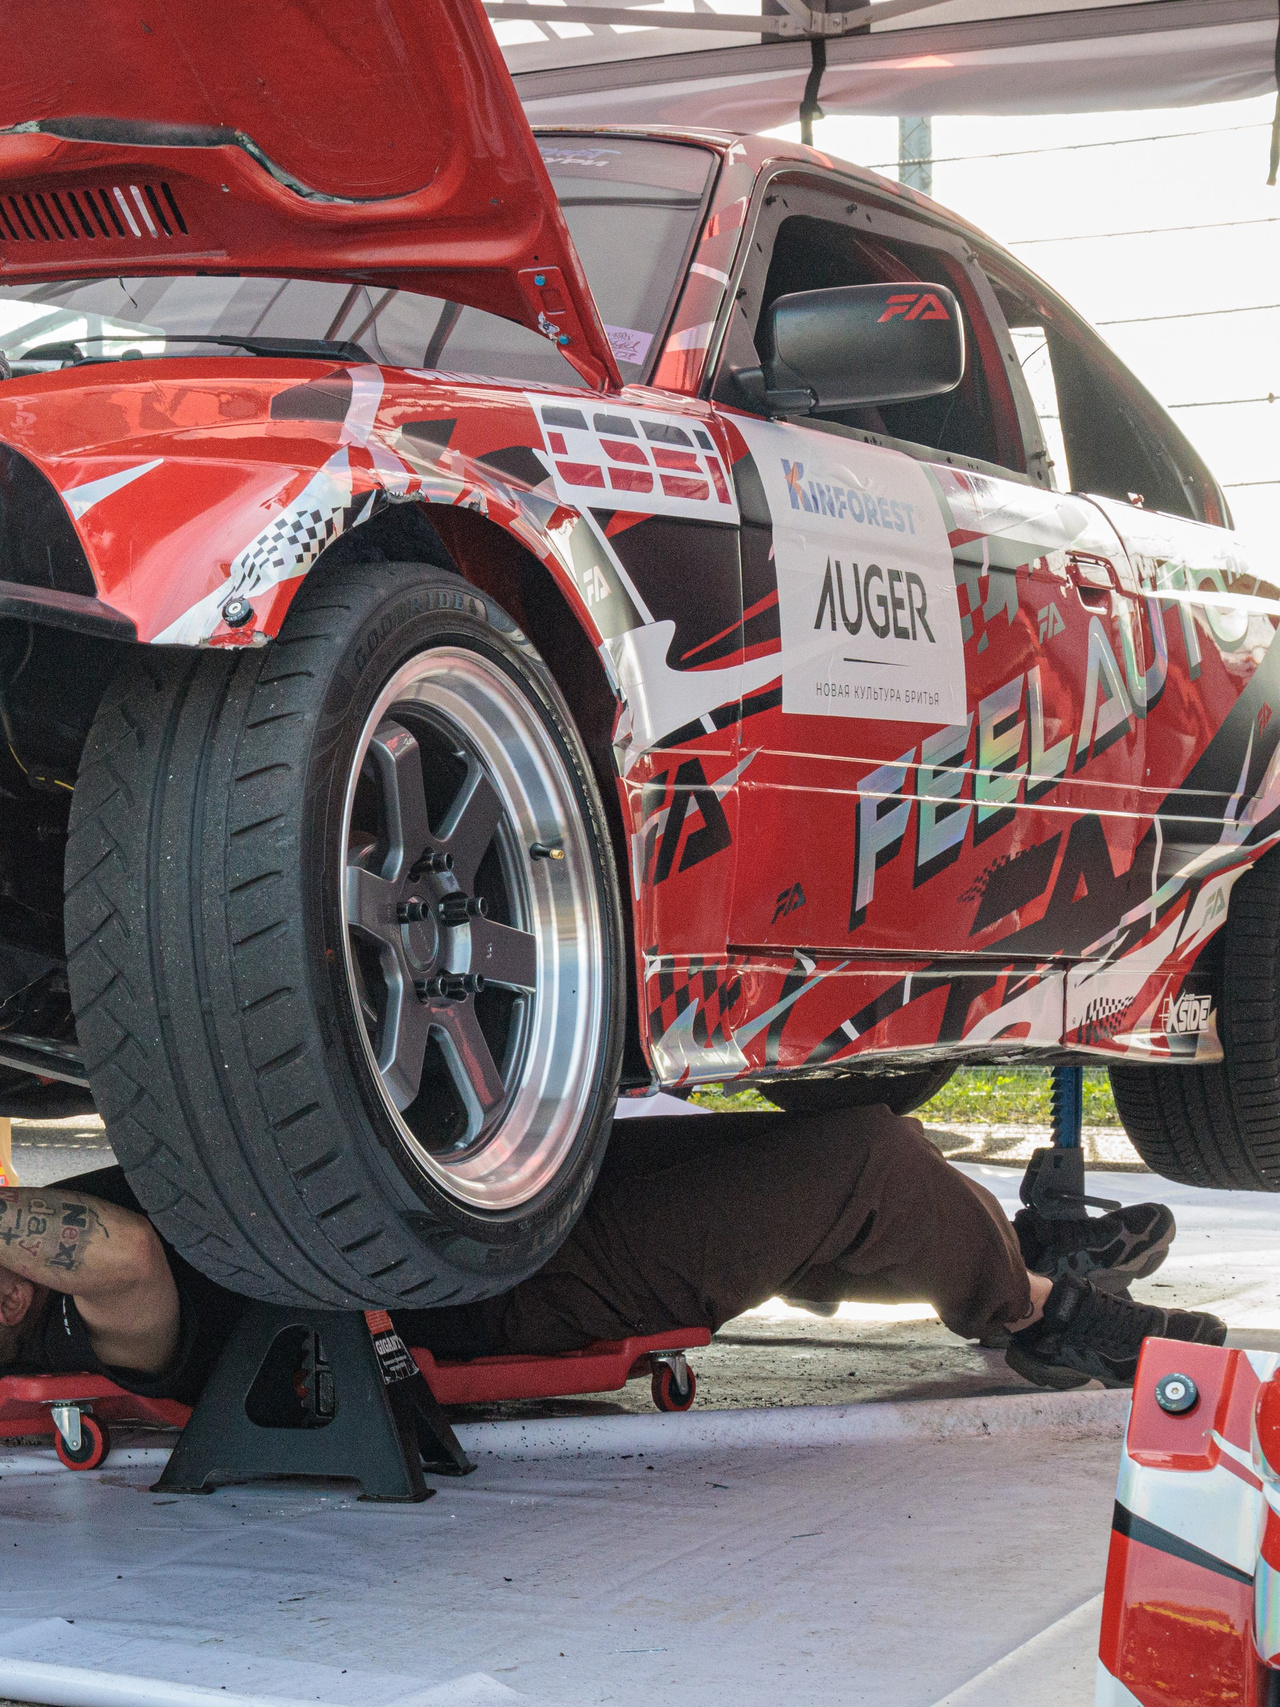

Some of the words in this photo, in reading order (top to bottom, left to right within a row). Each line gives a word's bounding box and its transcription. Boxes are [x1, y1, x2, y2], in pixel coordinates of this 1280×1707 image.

[877, 293, 950, 323] FA
[781, 458, 915, 535] KINFOREST
[583, 565, 612, 607] FA
[814, 555, 936, 644] AUGER
[816, 682, 850, 698] НОВАЯ
[854, 686, 901, 702] КУЛЬТУРА
[905, 690, 940, 705] БРИТЬЯ
[18, 1198, 57, 1258] day
[375, 1335, 402, 1356] GIGANT
